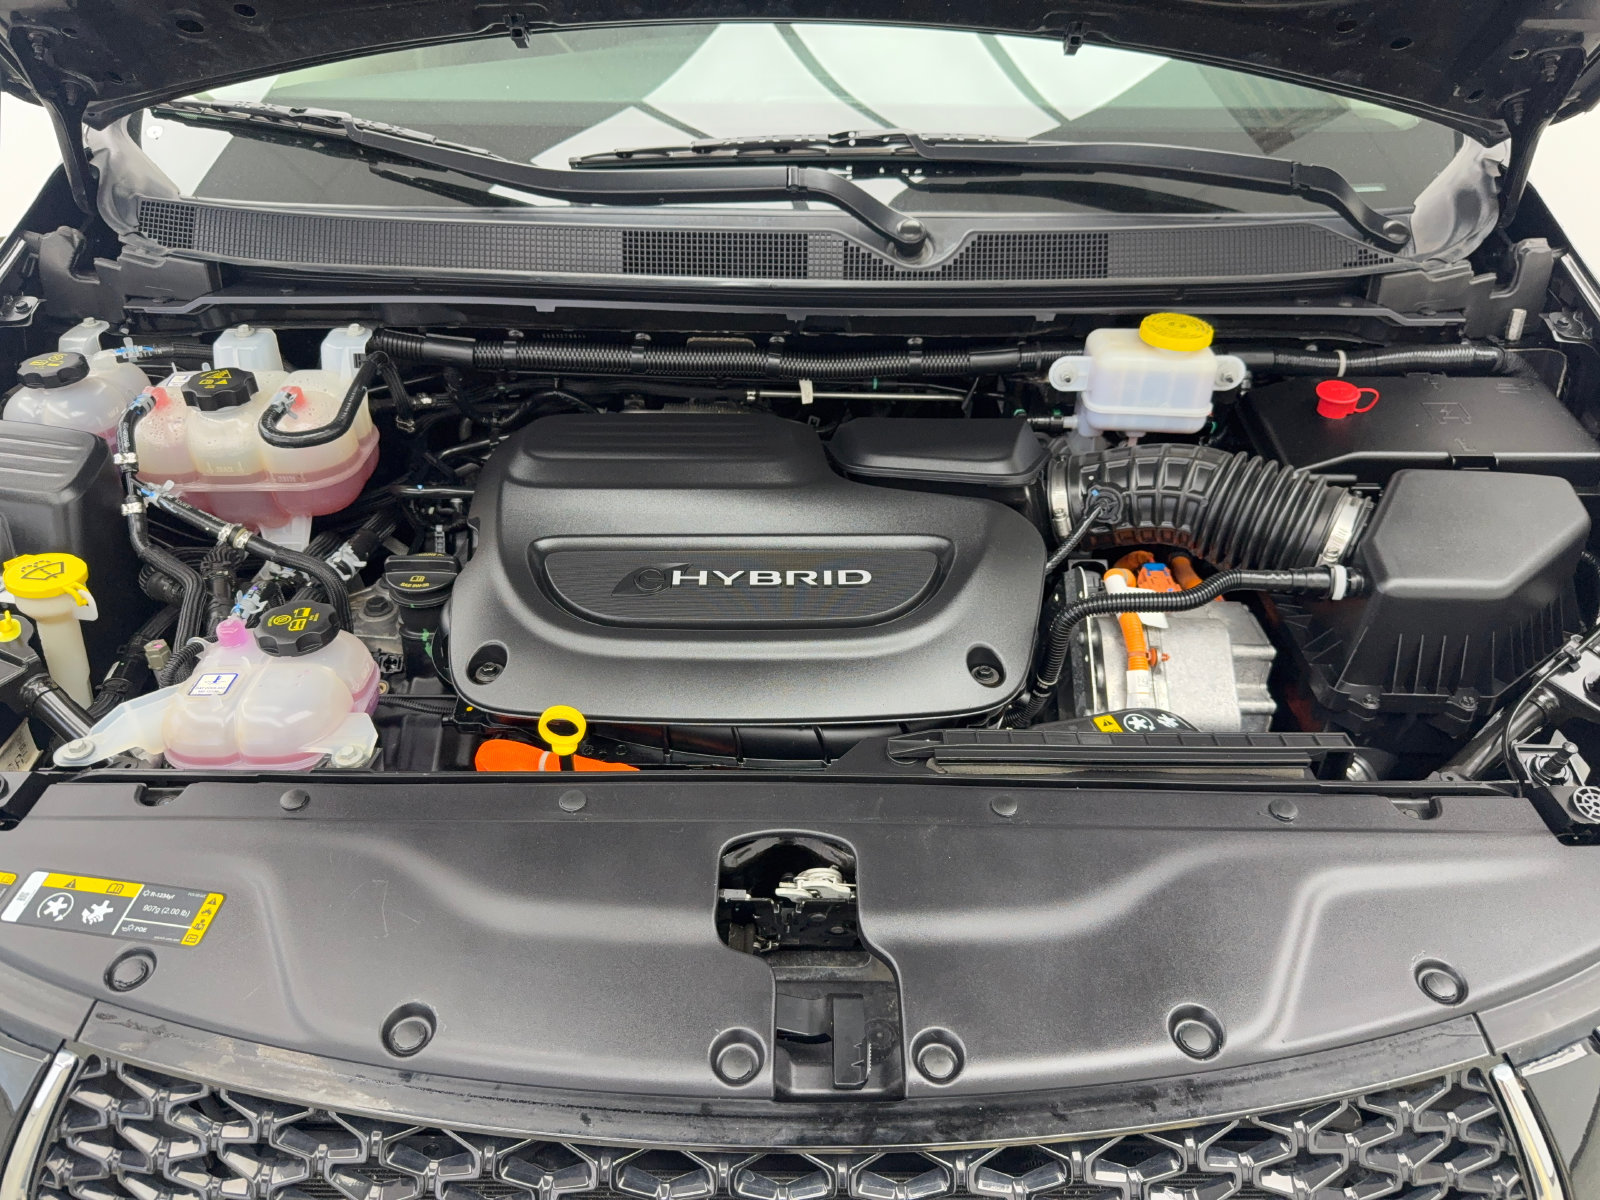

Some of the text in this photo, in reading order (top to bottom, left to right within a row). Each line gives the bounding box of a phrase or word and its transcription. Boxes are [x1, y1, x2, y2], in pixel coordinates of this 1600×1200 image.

[672, 570, 872, 587] HYBRID
[142, 904, 191, 918] 907g (2.00 lb)
